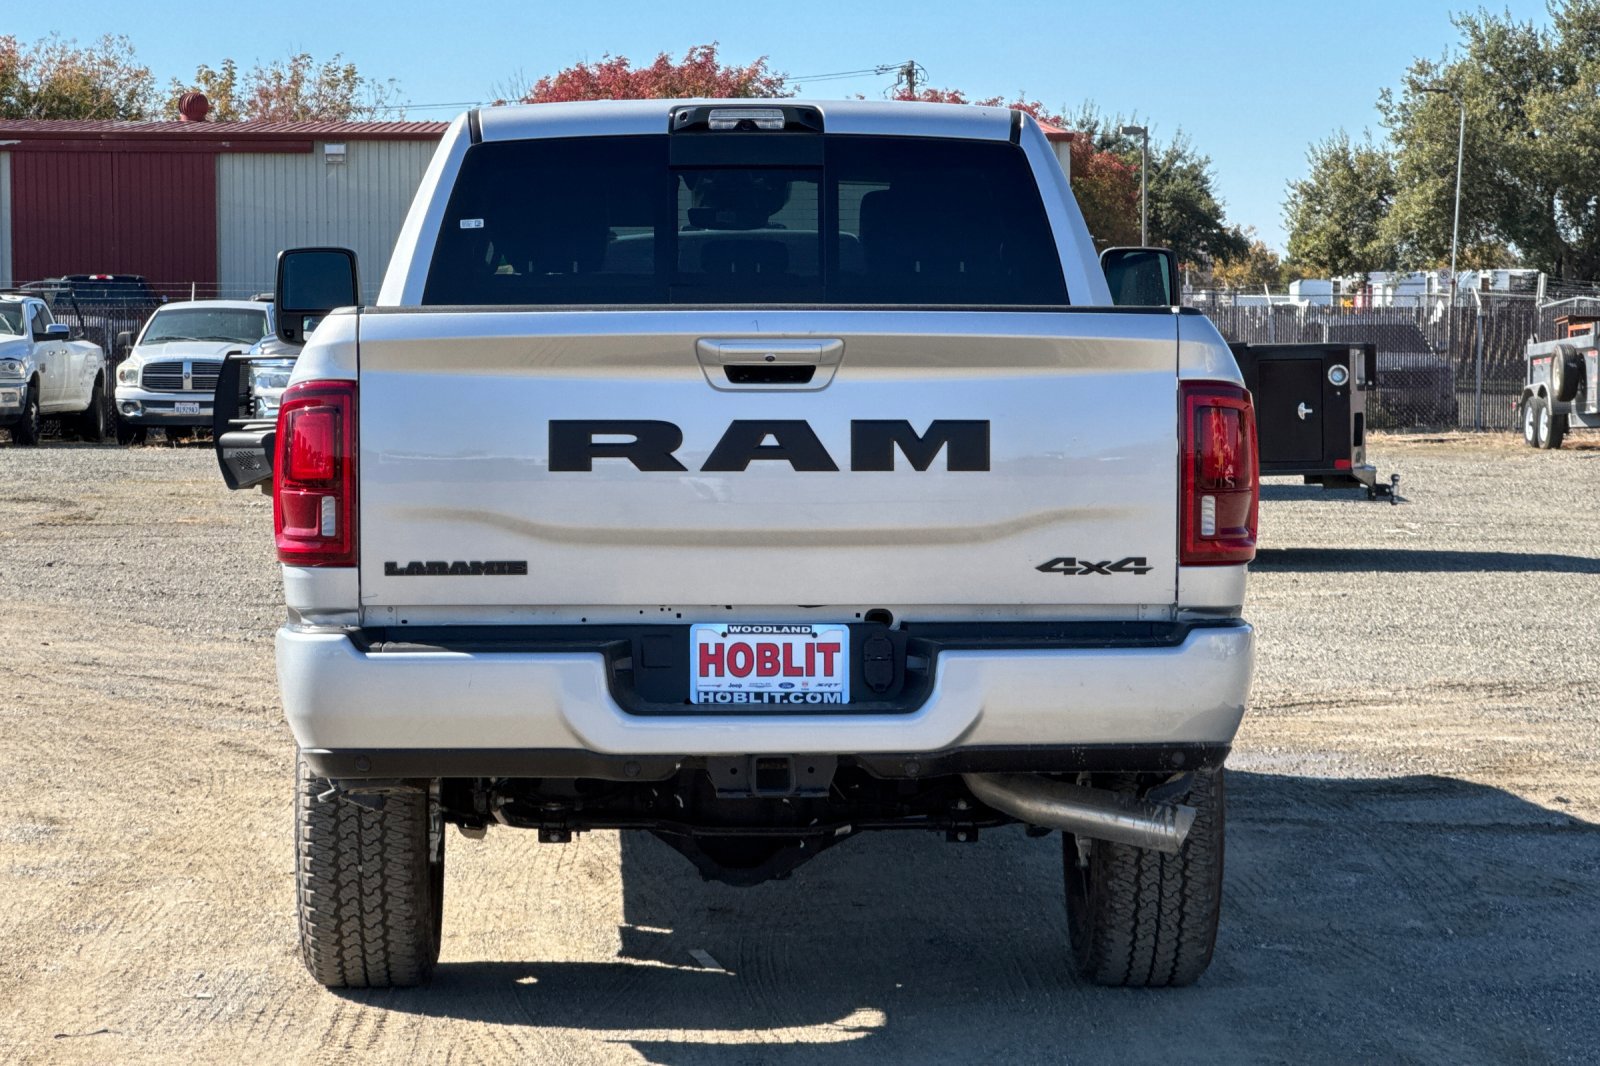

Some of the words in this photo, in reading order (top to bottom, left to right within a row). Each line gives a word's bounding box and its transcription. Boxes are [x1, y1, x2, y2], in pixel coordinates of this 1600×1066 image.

[548, 419, 990, 472] RAM
[384, 560, 528, 576] LARAMIE
[1034, 557, 1154, 575] 4x4
[728, 625, 811, 633] WOODLAND
[699, 642, 841, 678] HOBLIT
[699, 692, 840, 704] HOBLIT.COM
